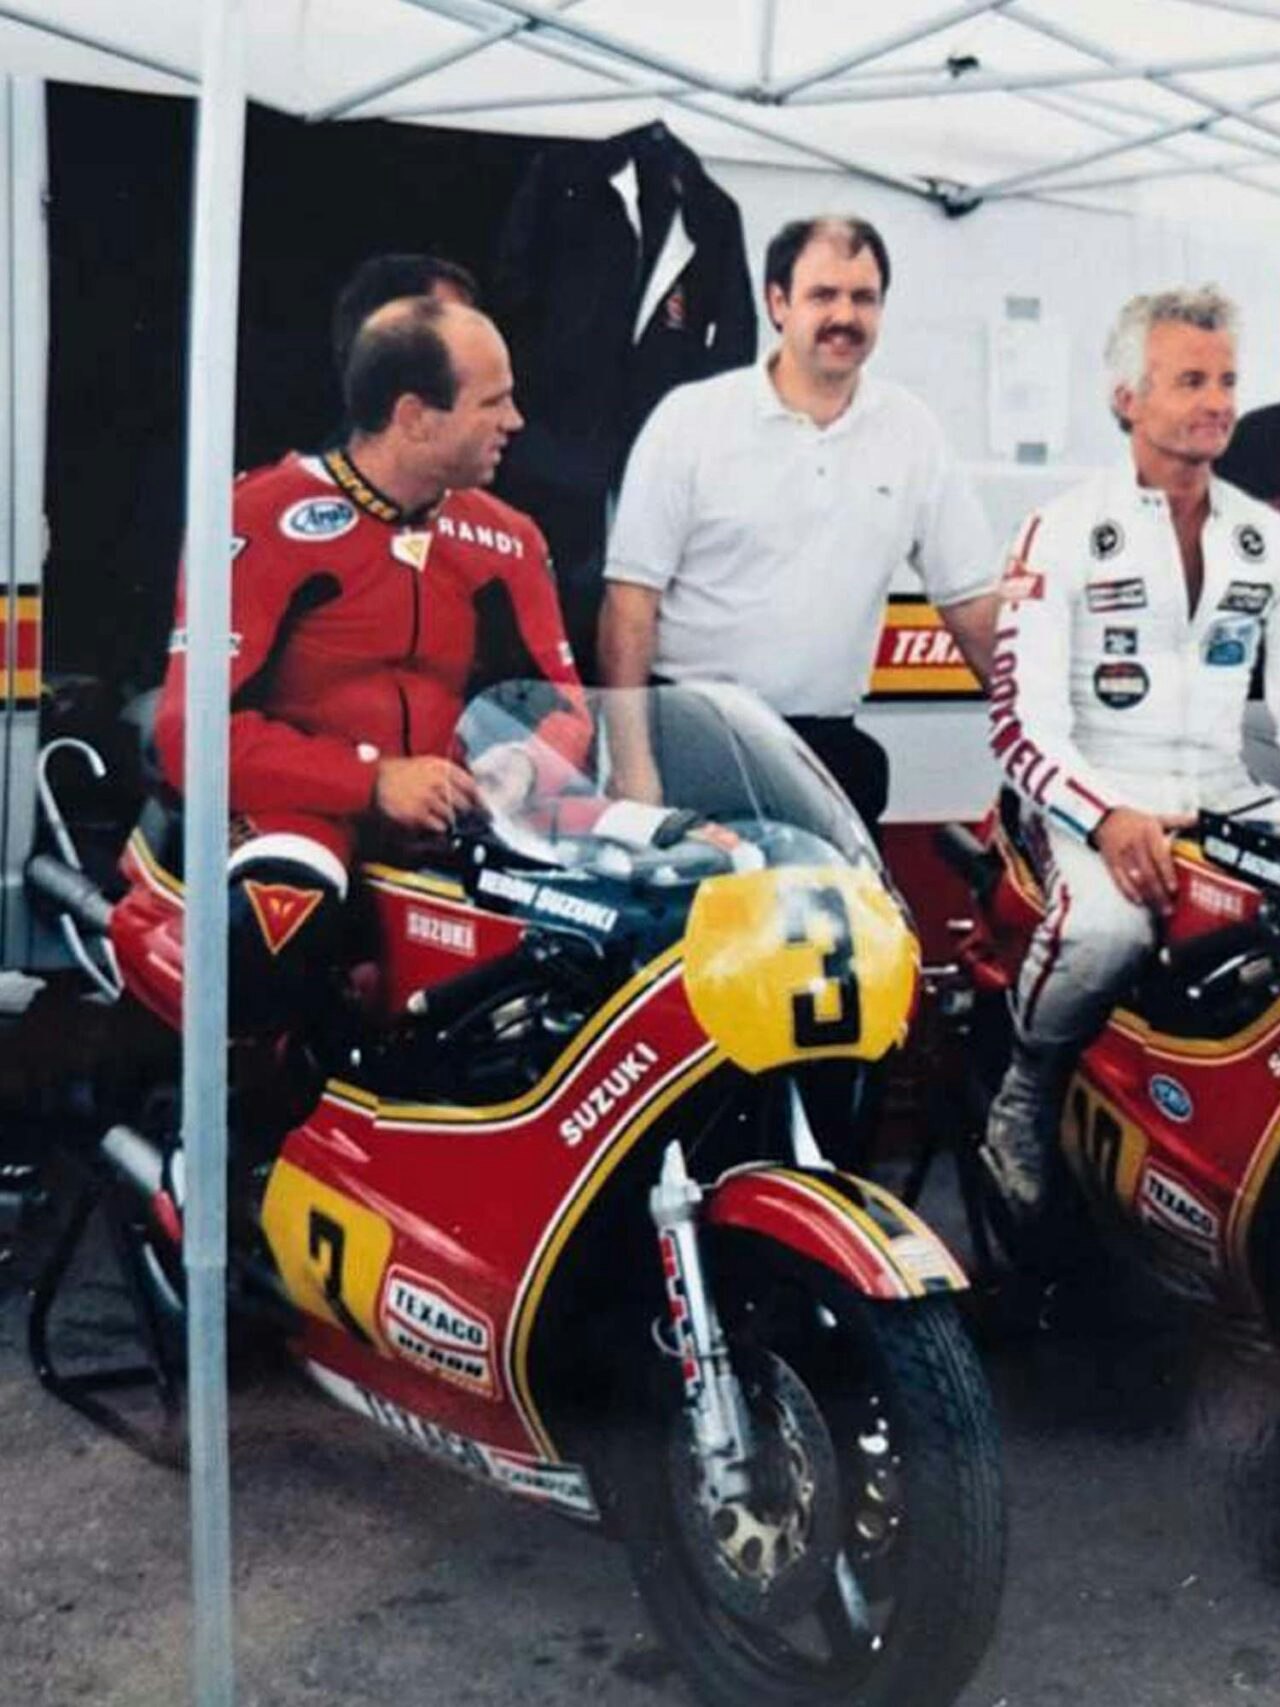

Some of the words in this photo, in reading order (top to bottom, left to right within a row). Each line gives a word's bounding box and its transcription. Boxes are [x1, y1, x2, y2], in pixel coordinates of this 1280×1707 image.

[439, 516, 523, 558] RANDY
[407, 910, 475, 955] SUZUKI
[559, 1042, 661, 1147] SUZUKI
[395, 1285, 484, 1346] TEXACO
